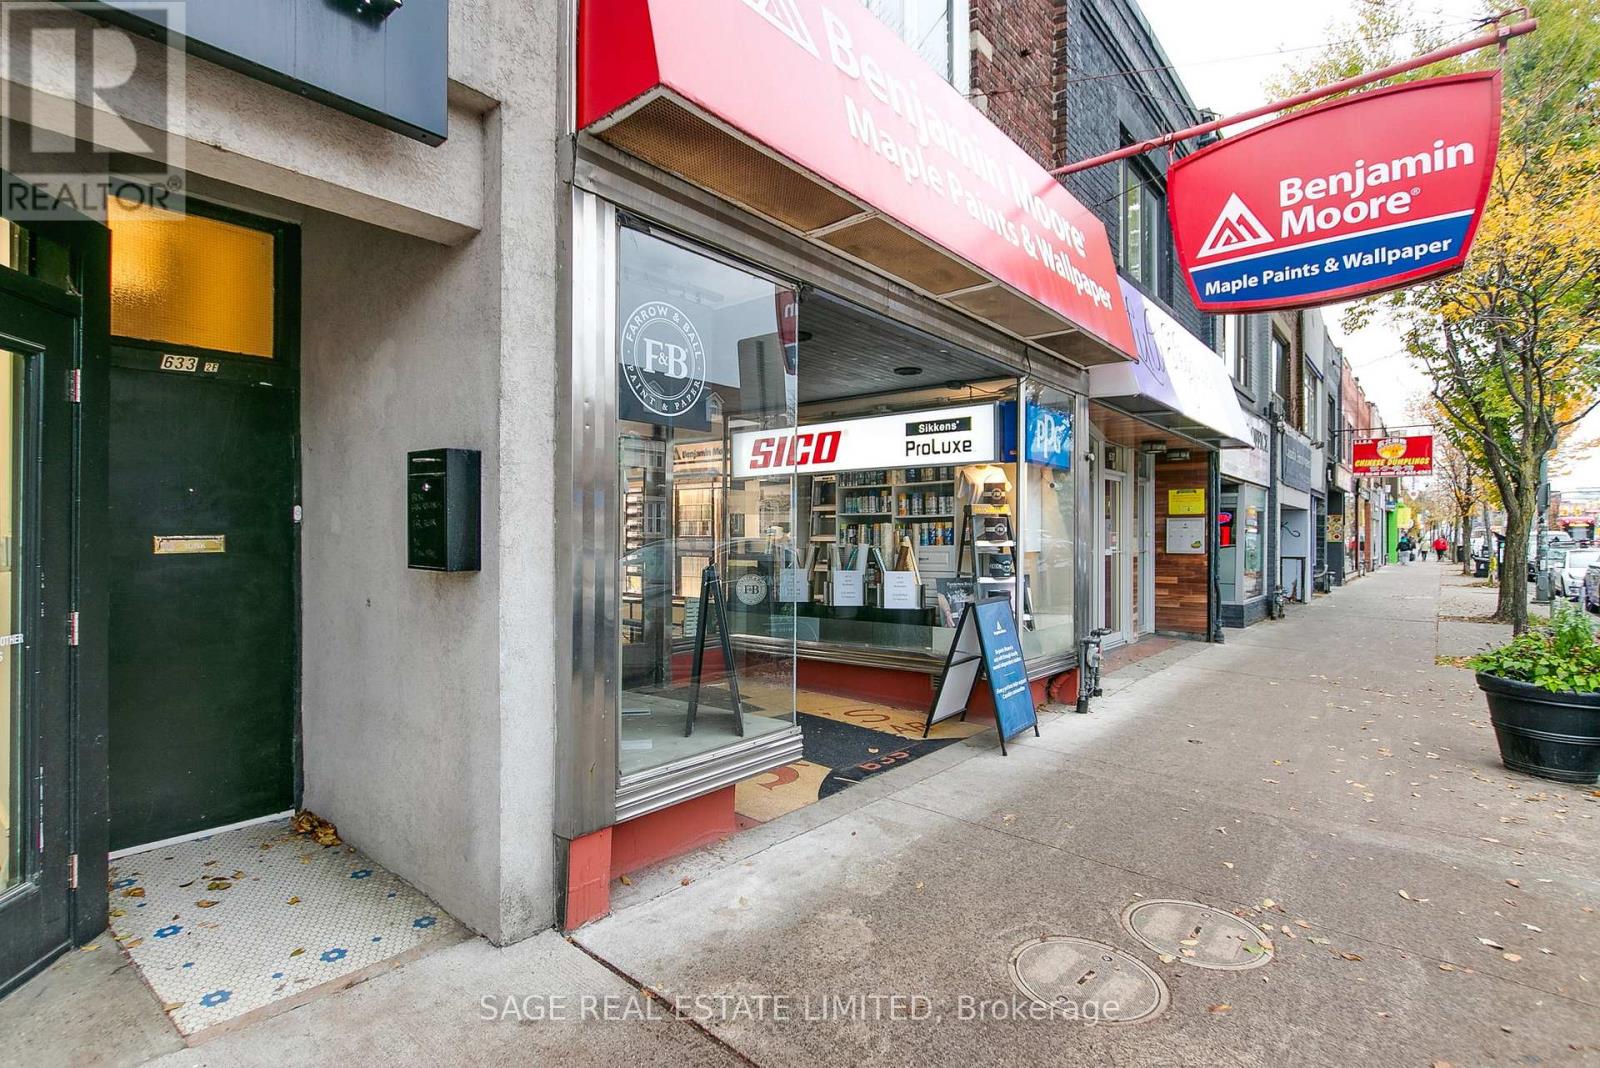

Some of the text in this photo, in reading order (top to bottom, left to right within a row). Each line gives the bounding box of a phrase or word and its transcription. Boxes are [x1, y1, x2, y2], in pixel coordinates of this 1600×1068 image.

[821, 5, 1087, 258] Benjamin Moore
[1279, 138, 1474, 207] Benjamin
[843, 94, 1112, 310] Maple Paints & Wallpaper
[1280, 188, 1412, 239] Moore
[1205, 238, 1453, 296] Maple Paints & Wallpaper
[626, 305, 702, 360] FARROW & BALL
[164, 355, 218, 371] 633 2F
[643, 338, 688, 379] F&B
[627, 365, 701, 411] PAINT & PAPER
[750, 431, 842, 469] SICO
[906, 439, 972, 457] ProLuxe
[918, 421, 957, 434] Sikkens
[1355, 457, 1430, 467] CHINESE DUMPLINGS
